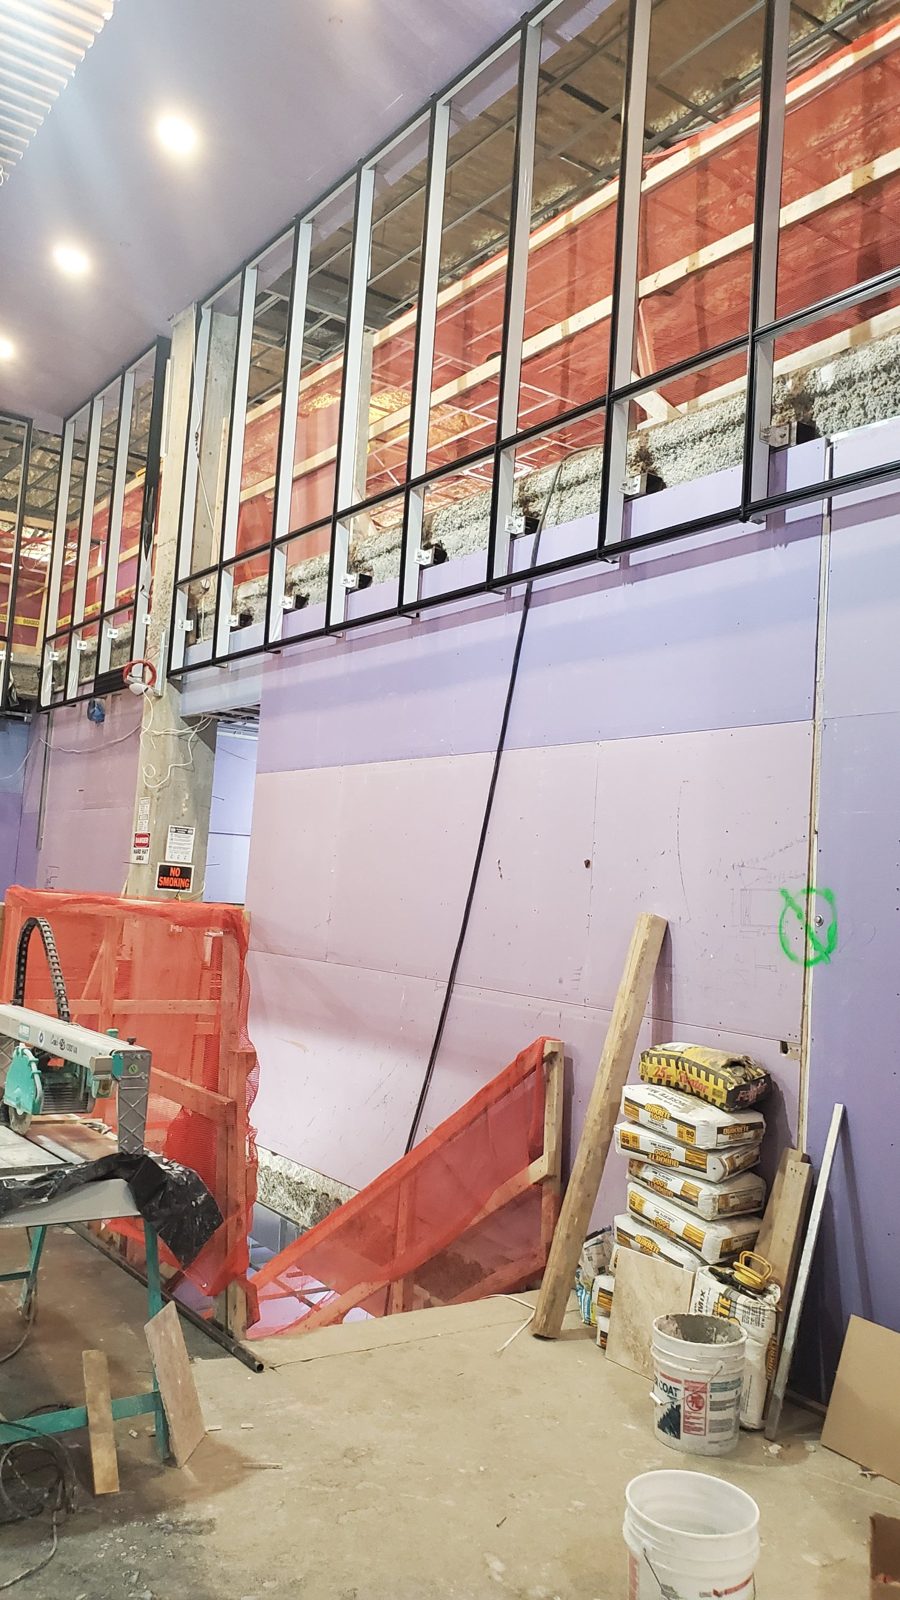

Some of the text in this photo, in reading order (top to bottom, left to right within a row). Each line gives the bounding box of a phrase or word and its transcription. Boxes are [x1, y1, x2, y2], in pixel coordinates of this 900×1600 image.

[170, 867, 180, 877] NO
[158, 876, 190, 888] SMOKING
[653, 1066, 666, 1079] 25
[698, 1290, 706, 1314] MIX
[658, 1382, 682, 1397] COAT
